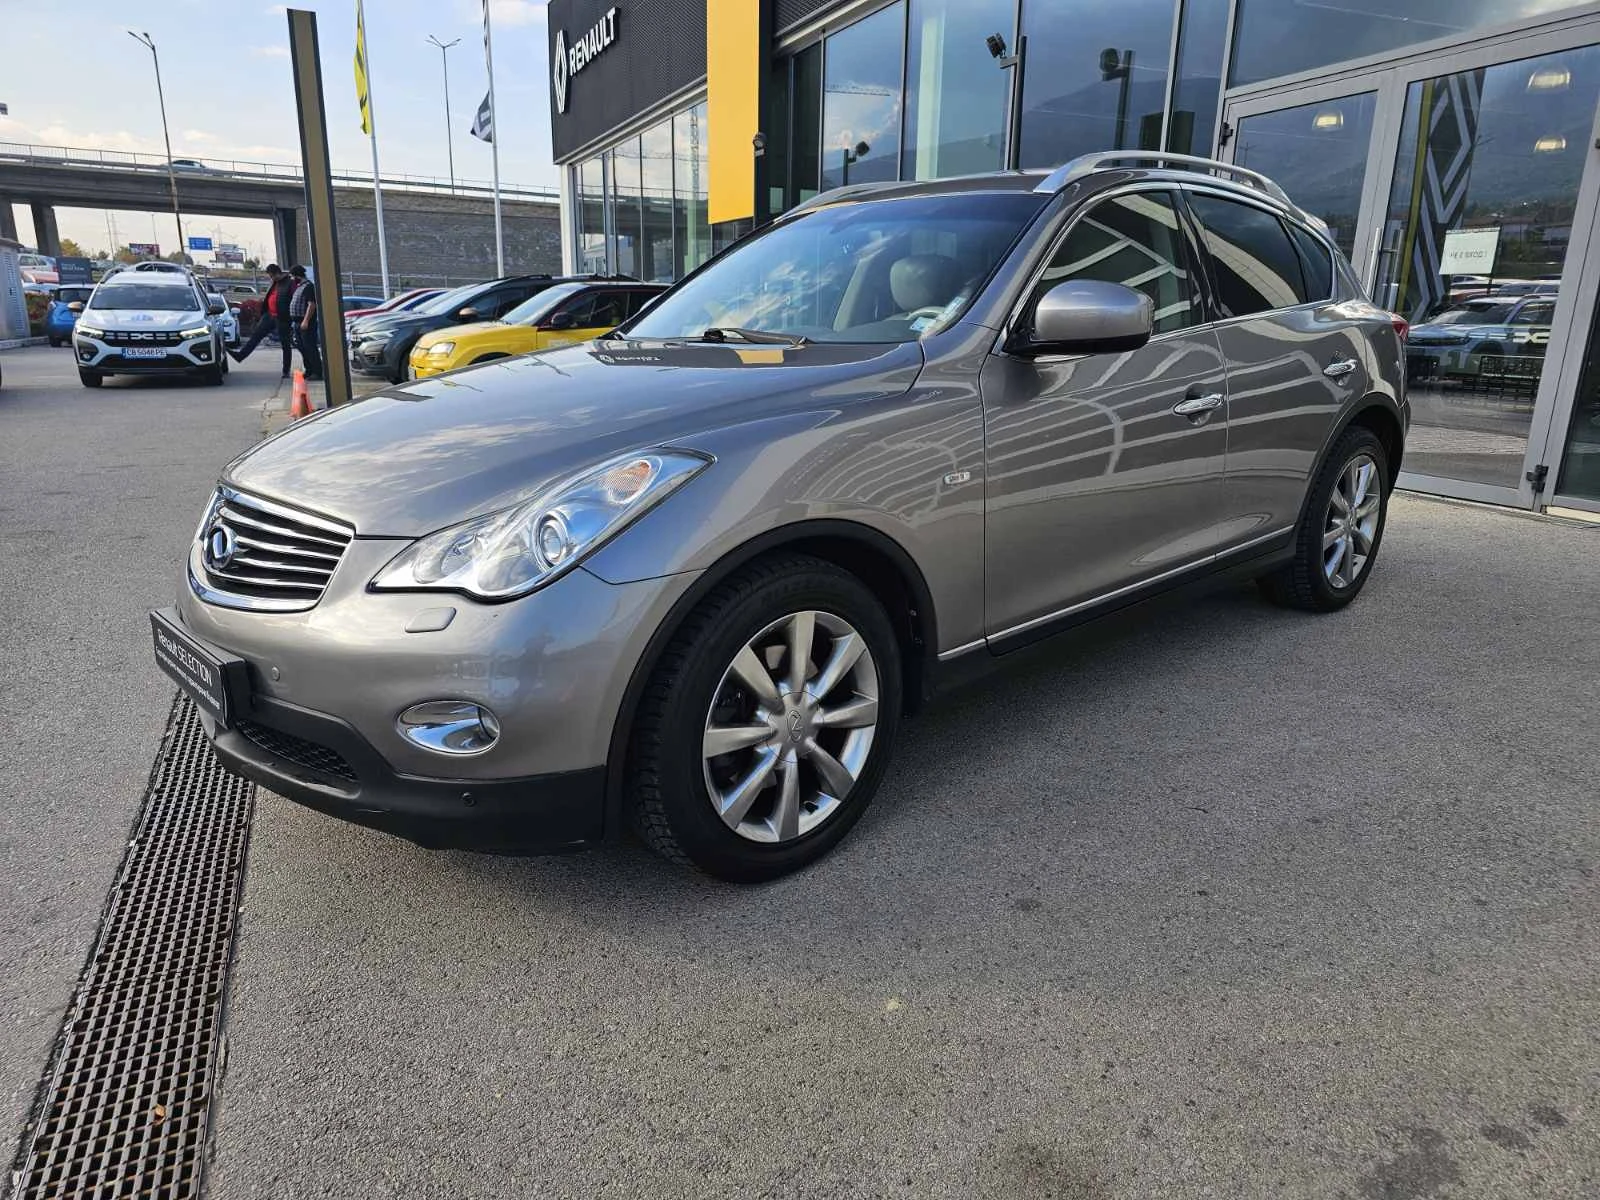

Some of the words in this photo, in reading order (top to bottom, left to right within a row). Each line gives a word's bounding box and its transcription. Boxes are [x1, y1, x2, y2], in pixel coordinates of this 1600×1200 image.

[569, 7, 616, 76] RENAULT
[157, 628, 179, 659] Renault
[178, 645, 213, 688] SELECTION
